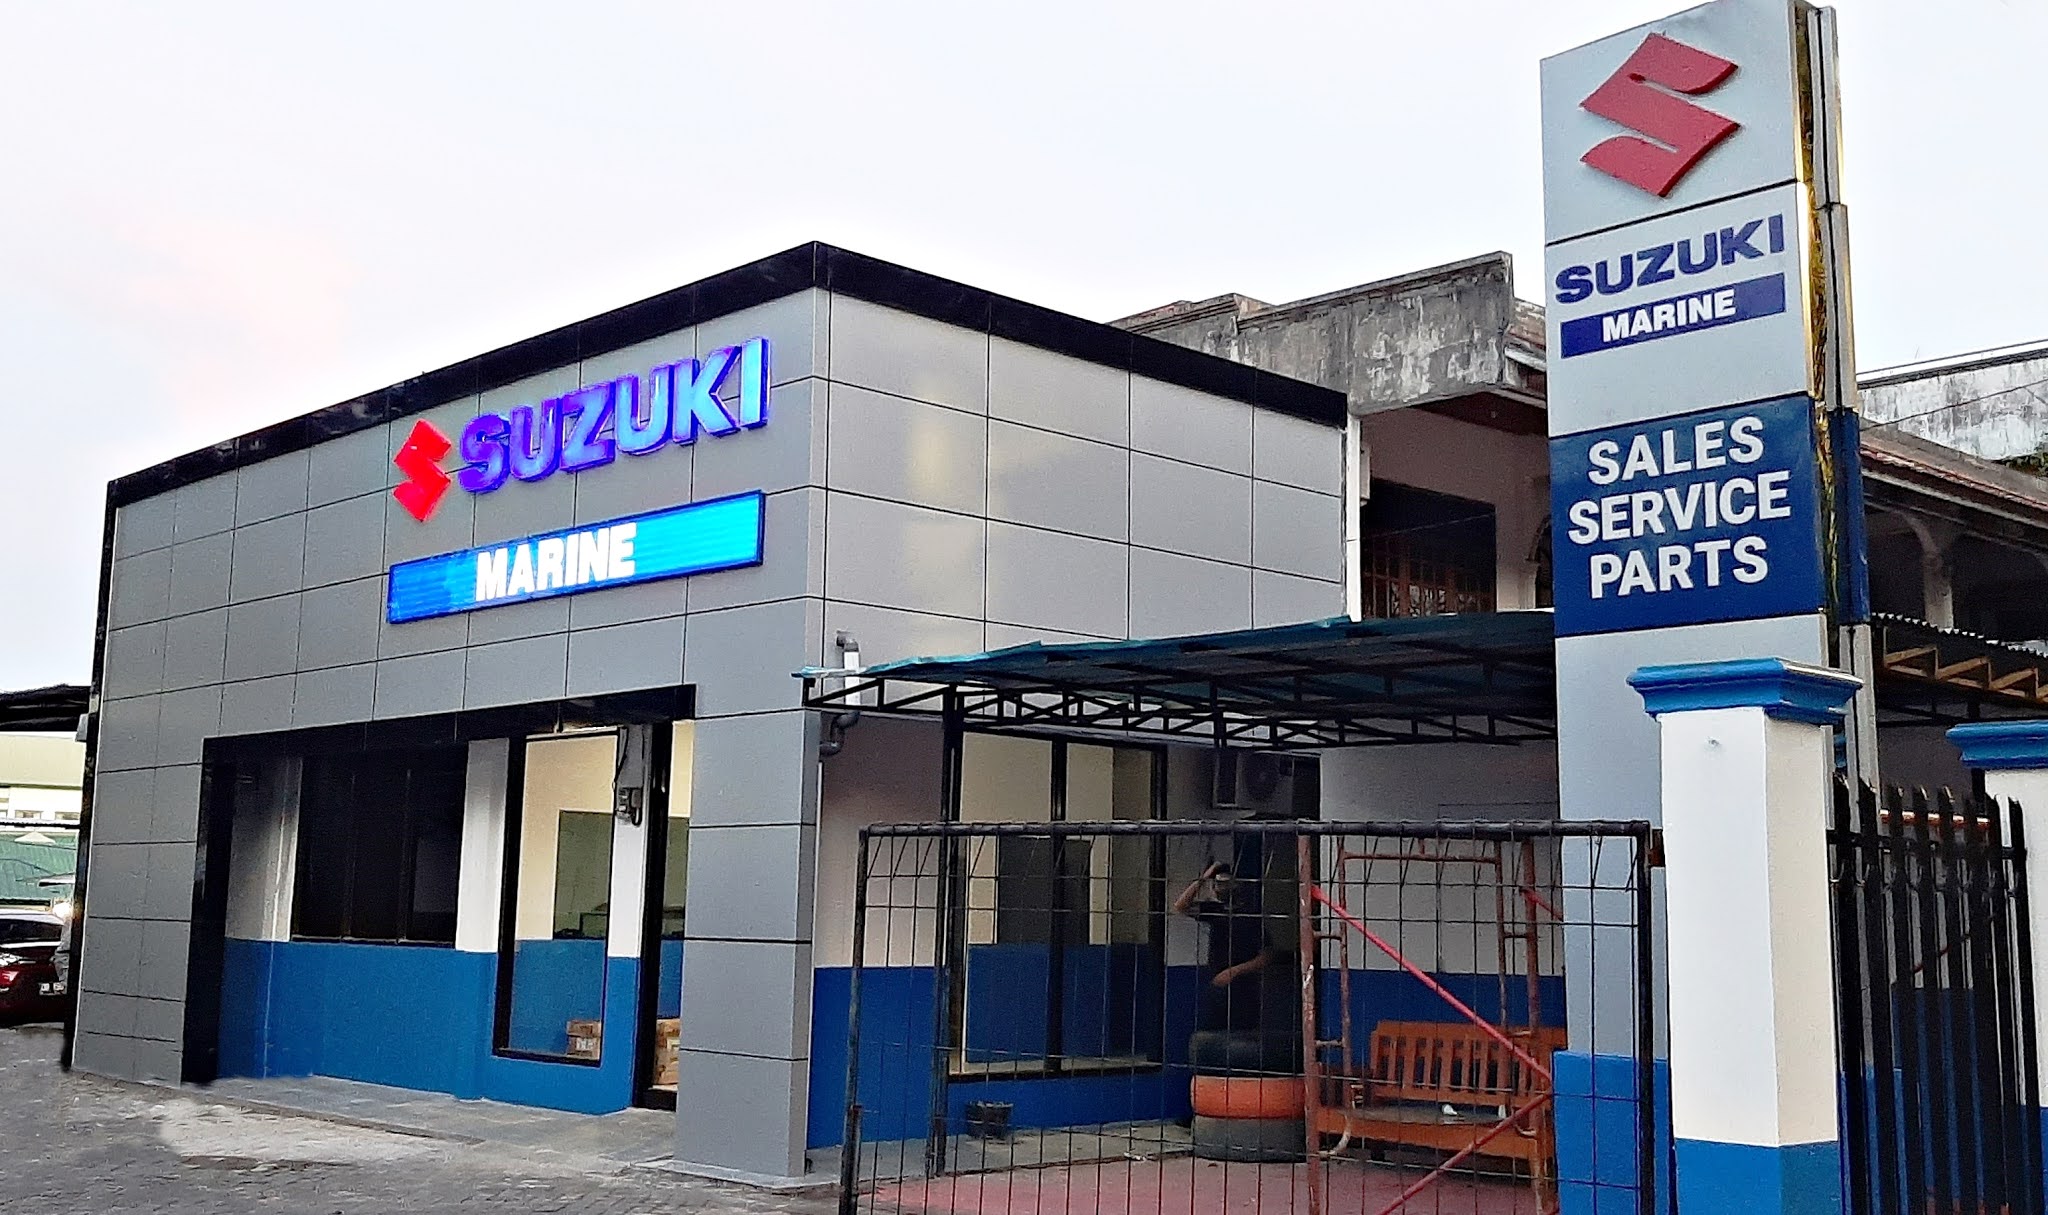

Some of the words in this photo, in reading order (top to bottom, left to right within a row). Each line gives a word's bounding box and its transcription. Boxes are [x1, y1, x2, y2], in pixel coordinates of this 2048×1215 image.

[1555, 213, 1785, 304] SUZUKI
[1602, 289, 1737, 343] MARINE
[459, 337, 771, 494] SUZUKI
[1588, 416, 1764, 486] SALES
[1568, 470, 1791, 545] SERVICE
[475, 522, 637, 602] MARINE
[1590, 536, 1768, 600] PARTS
